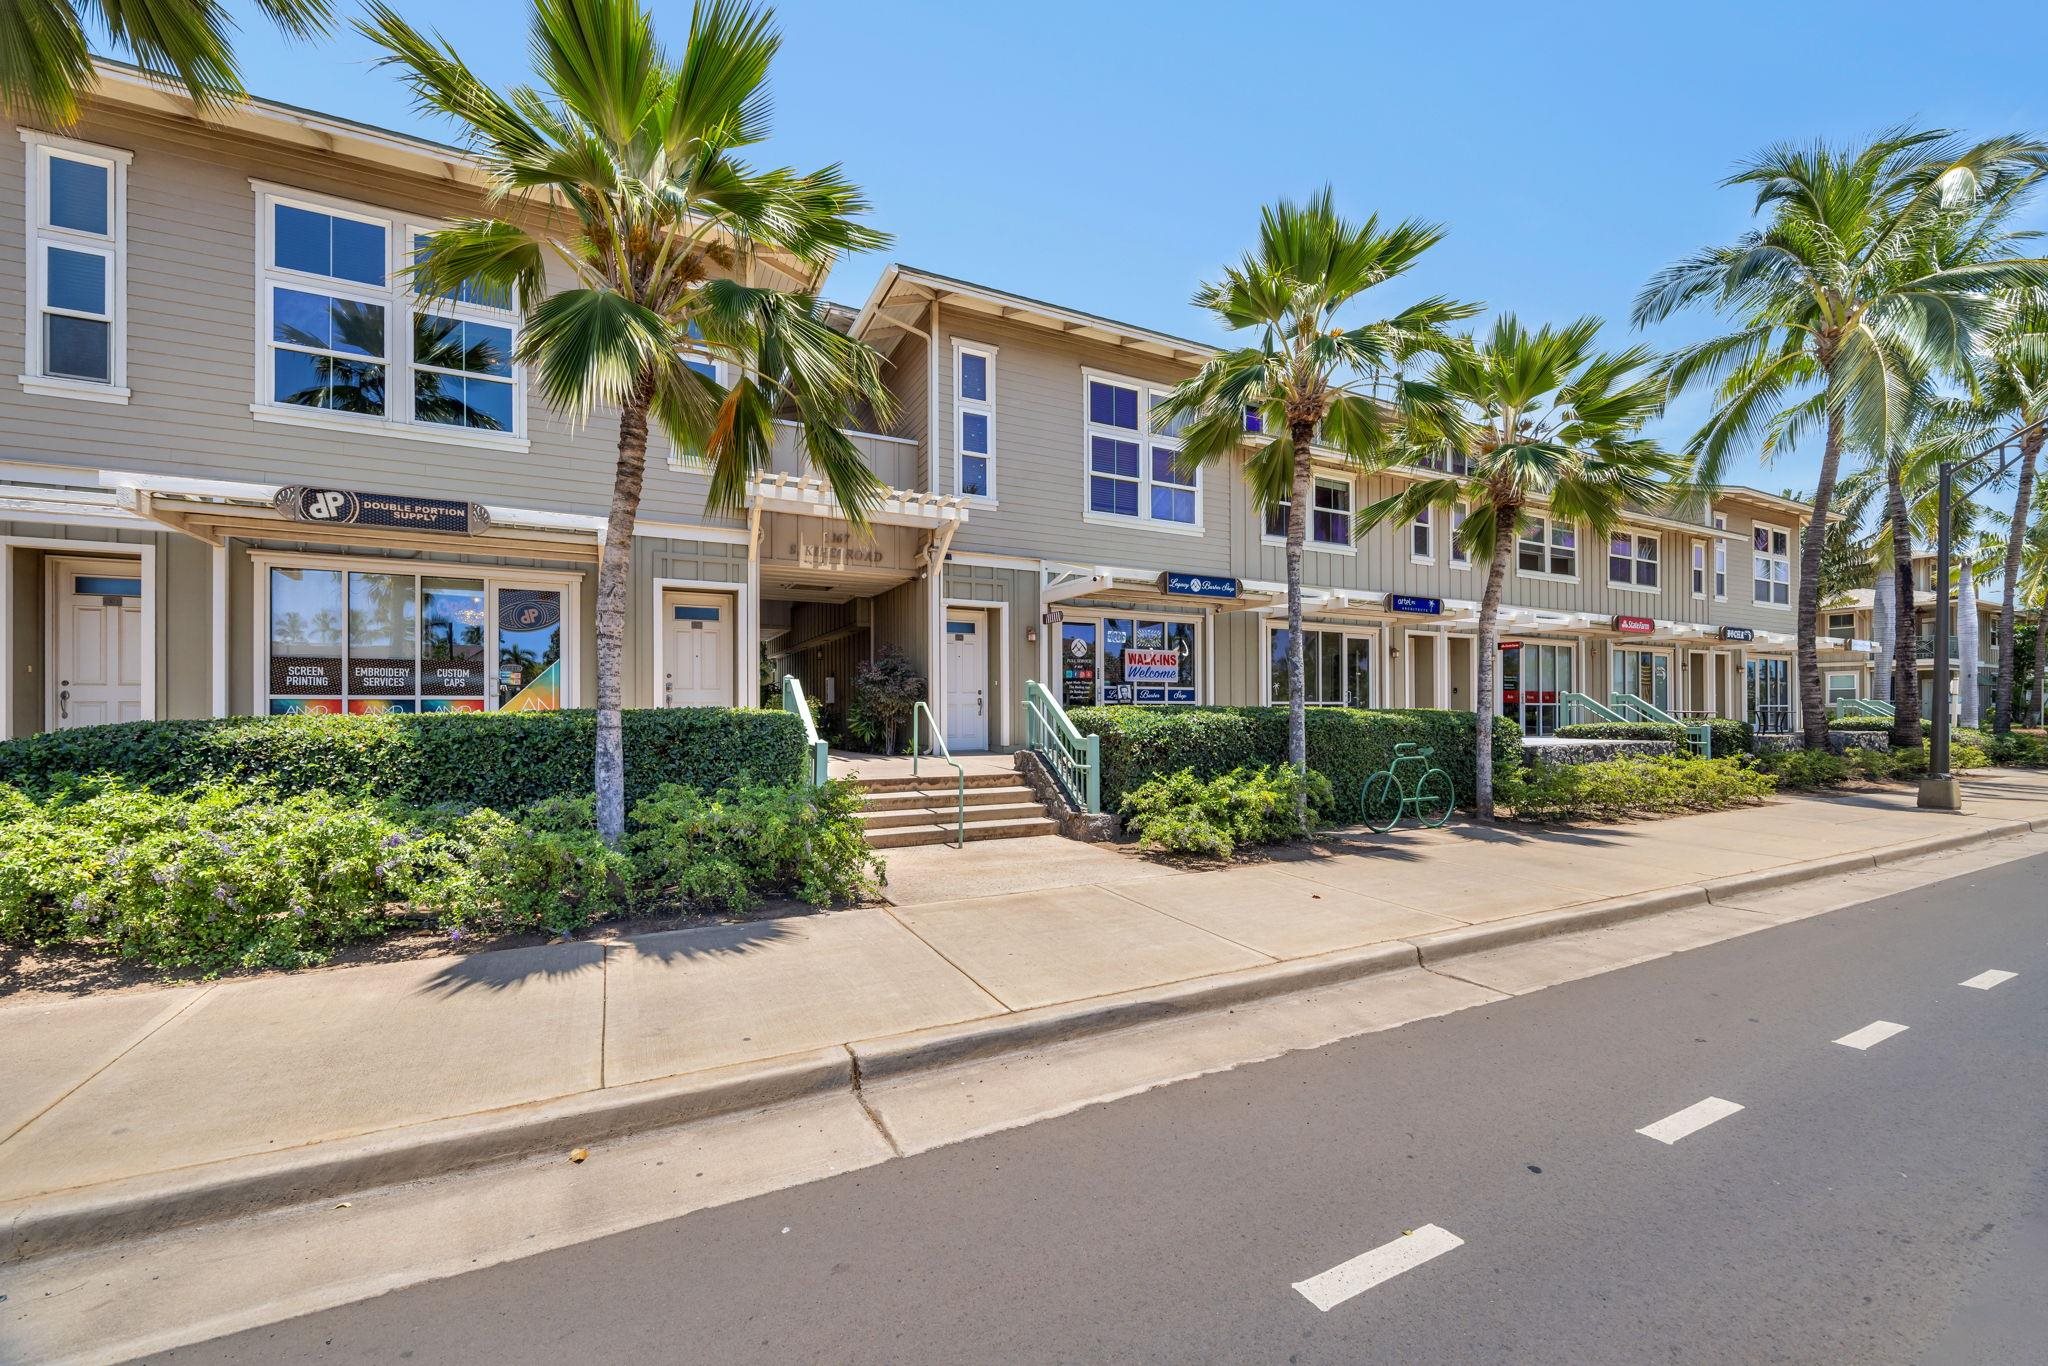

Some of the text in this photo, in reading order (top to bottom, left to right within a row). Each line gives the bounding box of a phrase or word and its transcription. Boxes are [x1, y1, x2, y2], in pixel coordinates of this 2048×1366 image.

[363, 501, 465, 517] DOUBLE PORTION
[393, 511, 438, 522] SUPPLY
[845, 548, 883, 563] ROAD
[1221, 582, 1235, 593] Shop
[1127, 652, 1177, 666] WALK-INS
[288, 666, 324, 676] SCREEN
[355, 667, 410, 678] EMBROIDERY
[436, 668, 470, 678] CUSTOM
[1127, 666, 1177, 679] Welcome
[286, 676, 329, 686] PRINTING
[363, 677, 405, 687] SERVICES
[443, 678, 466, 688] CAPS
